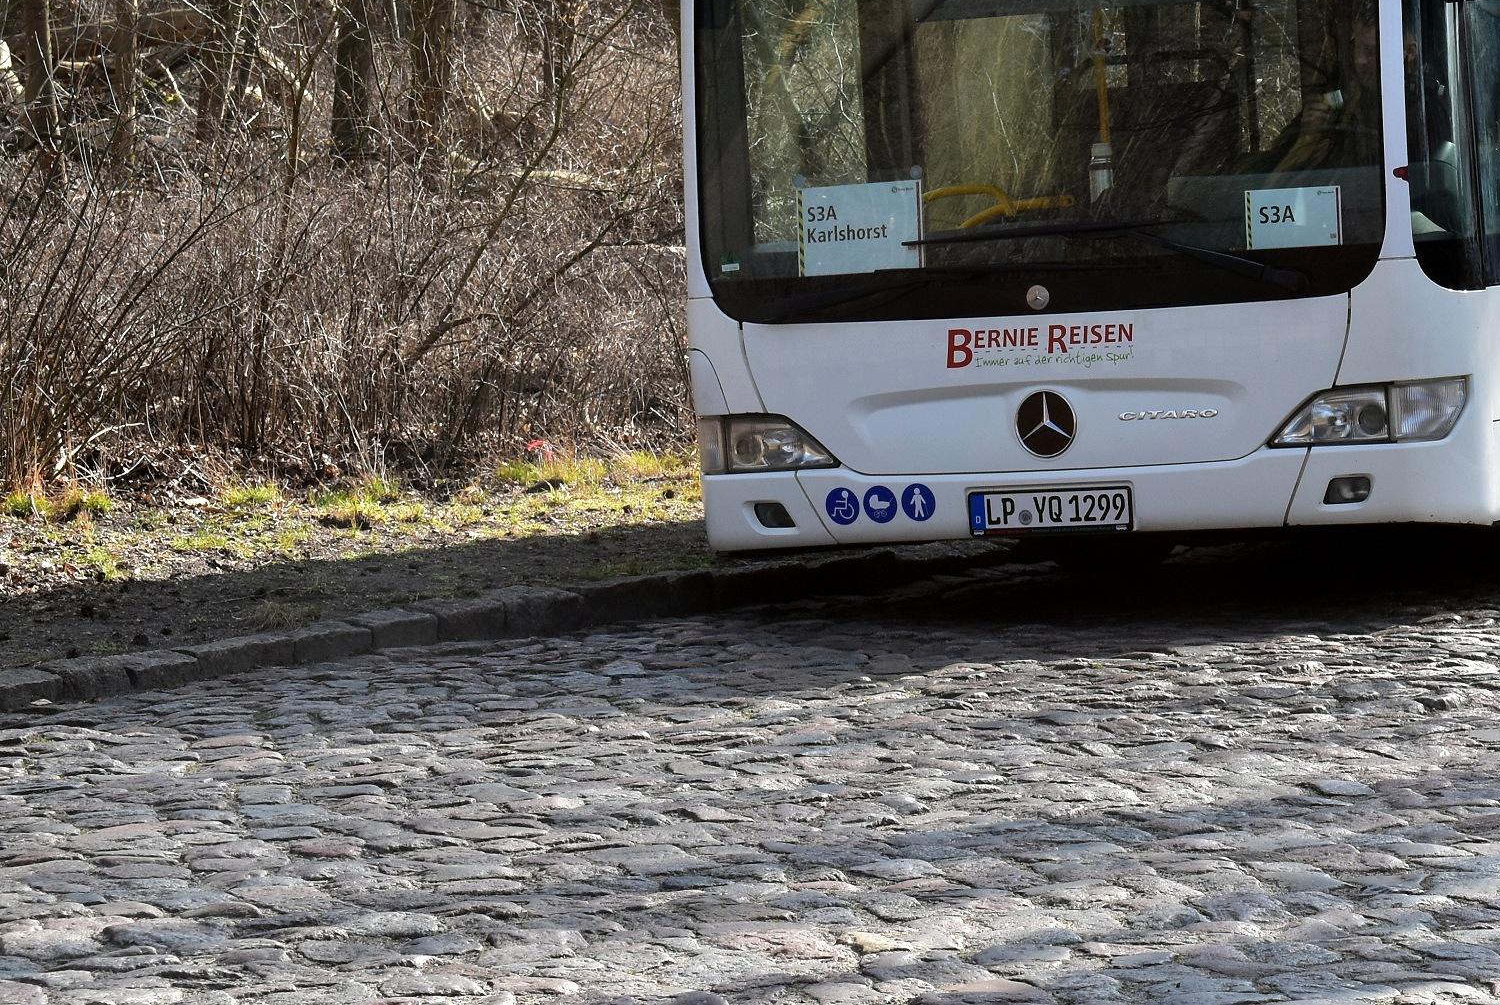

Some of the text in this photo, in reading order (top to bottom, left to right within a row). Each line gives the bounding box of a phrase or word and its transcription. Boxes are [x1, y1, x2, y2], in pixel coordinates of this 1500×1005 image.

[807, 205, 838, 222] S3A
[1259, 205, 1295, 224] S3A
[807, 224, 888, 244] Karlshorst
[946, 323, 1134, 368] BERNIE REISEN
[975, 357, 1009, 367] Immer
[1013, 355, 1031, 366] auf
[1034, 352, 1052, 365] der
[1055, 350, 1104, 369] richtigen
[1119, 408, 1219, 421] CITARO
[975, 493, 1126, 525] D LP YQ 1299
